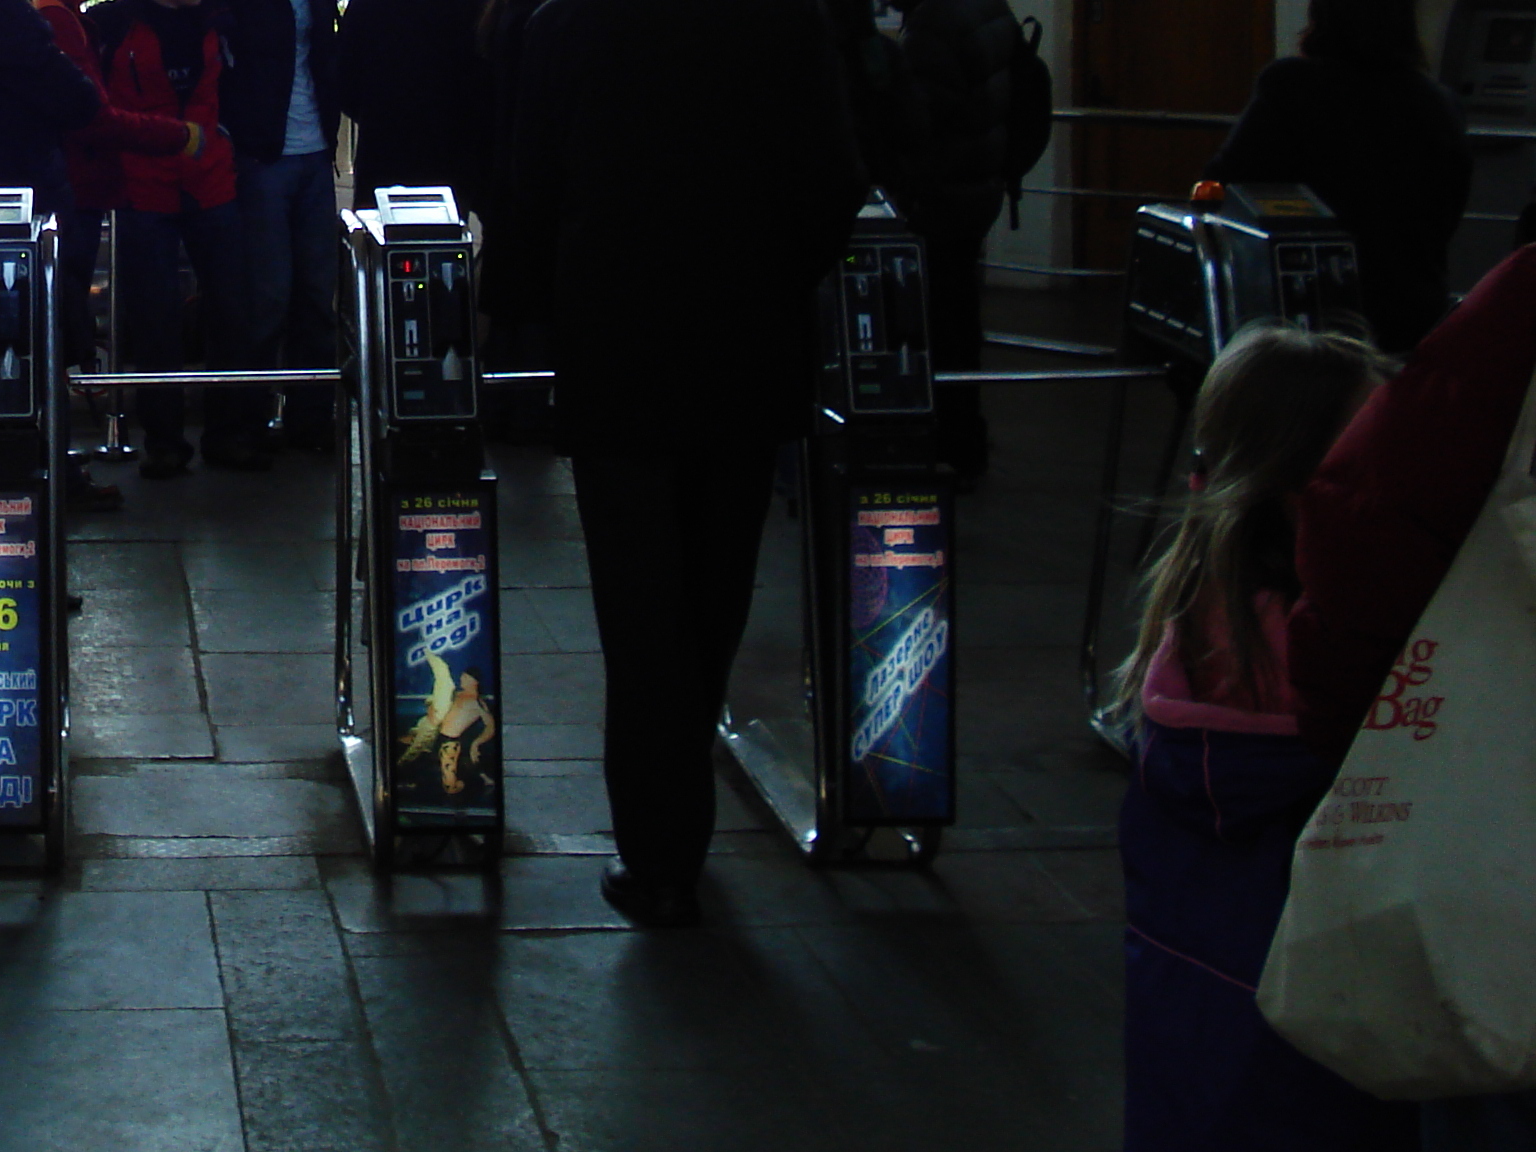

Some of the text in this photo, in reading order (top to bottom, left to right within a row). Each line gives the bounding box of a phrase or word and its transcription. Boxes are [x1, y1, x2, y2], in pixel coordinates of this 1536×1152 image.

[414, 497, 433, 508] 26
[437, 497, 479, 508] січня
[873, 493, 893, 504] 26
[896, 493, 938, 504] січня
[399, 511, 481, 532] НАЦІОНАЛЬНИЙ
[426, 533, 456, 551] ЦИРК
[396, 559, 411, 572] на
[27, 580, 35, 589] з
[1363, 670, 1445, 740] Bag
